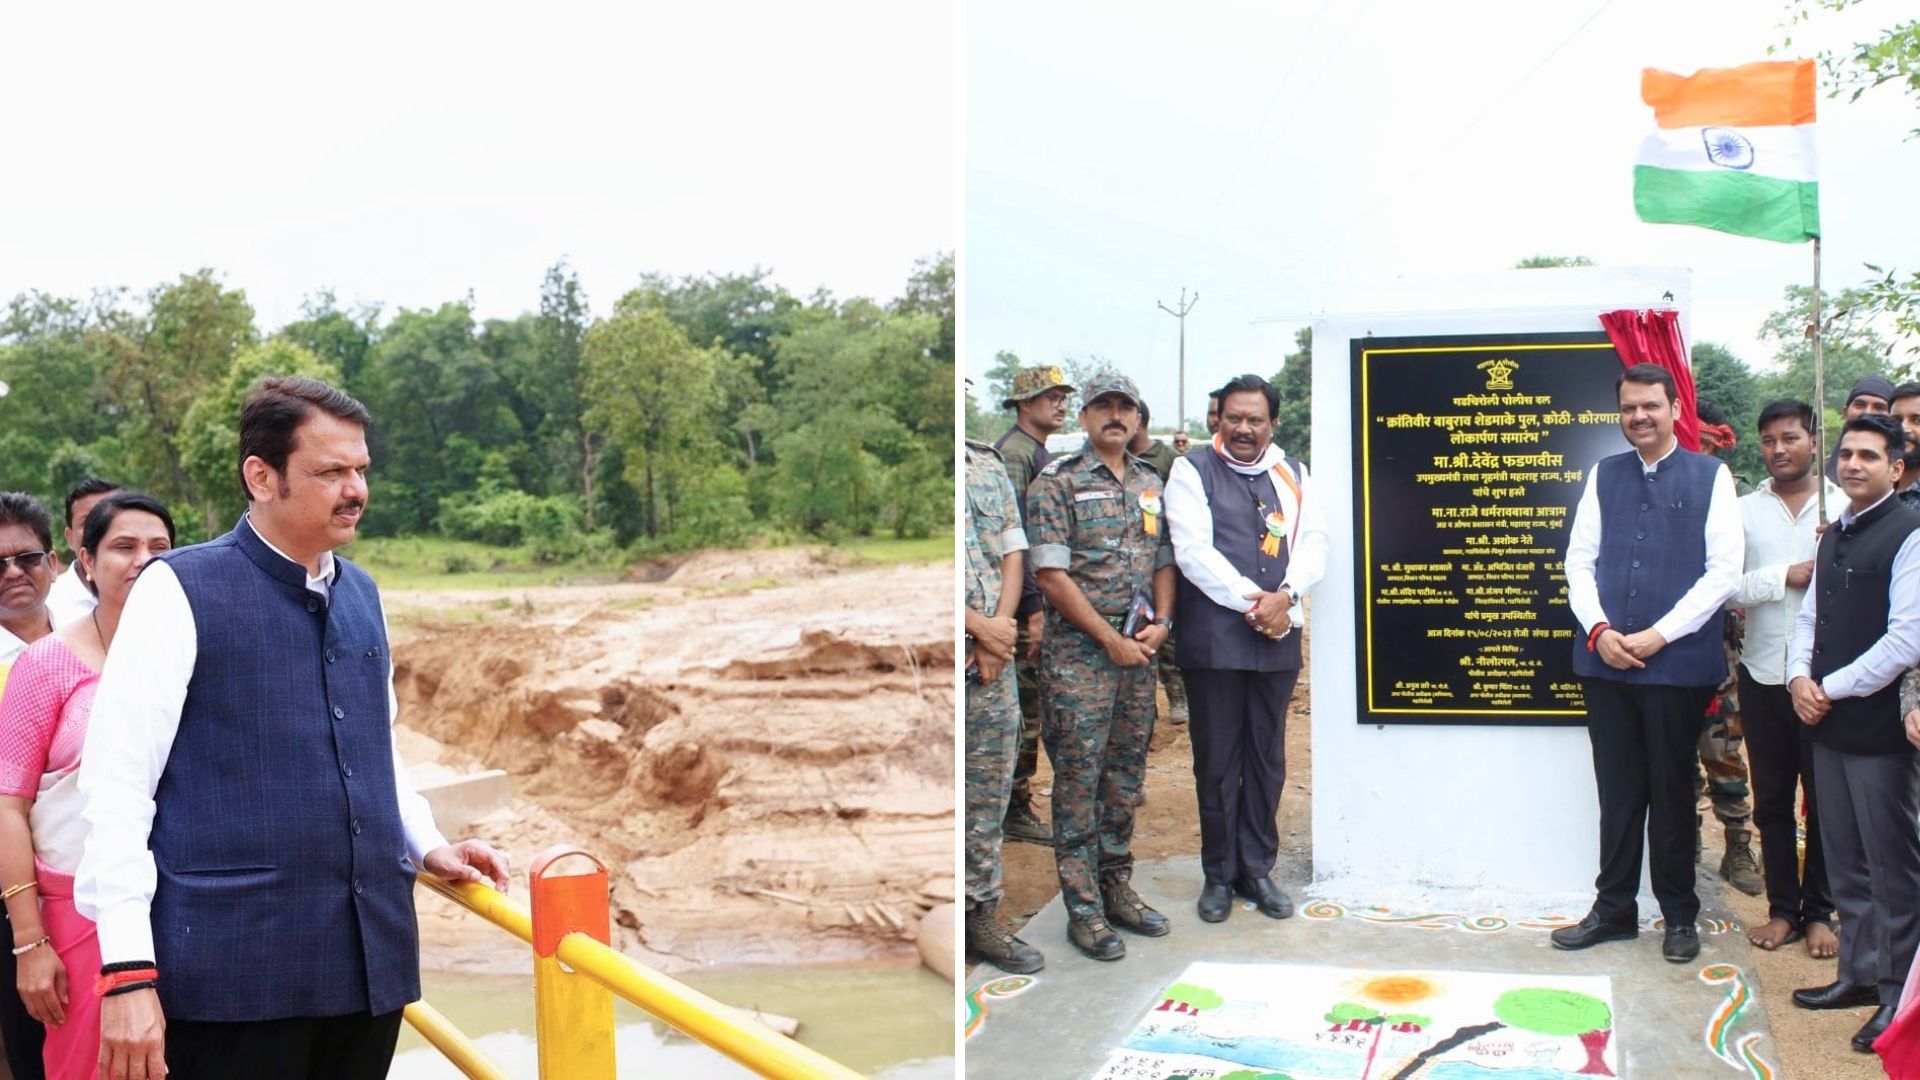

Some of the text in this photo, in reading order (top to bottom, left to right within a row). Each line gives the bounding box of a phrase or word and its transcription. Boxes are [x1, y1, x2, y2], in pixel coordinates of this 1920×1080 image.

[1452, 392, 1551, 406] गडचिरोली पोलीस दल
[1386, 413, 1431, 428] क्रांतिवीर
[1433, 415, 1472, 430] बाबुराव
[1474, 411, 1516, 427] शेडमाके
[1449, 430, 1498, 444] लोकार्पण
[1500, 430, 1539, 444] समारंभ
[1502, 450, 1564, 467] फडणवीस
[1536, 506, 1567, 517] आत्राम
[1492, 534, 1519, 545] अशोक
[1520, 534, 1534, 545] नेते
